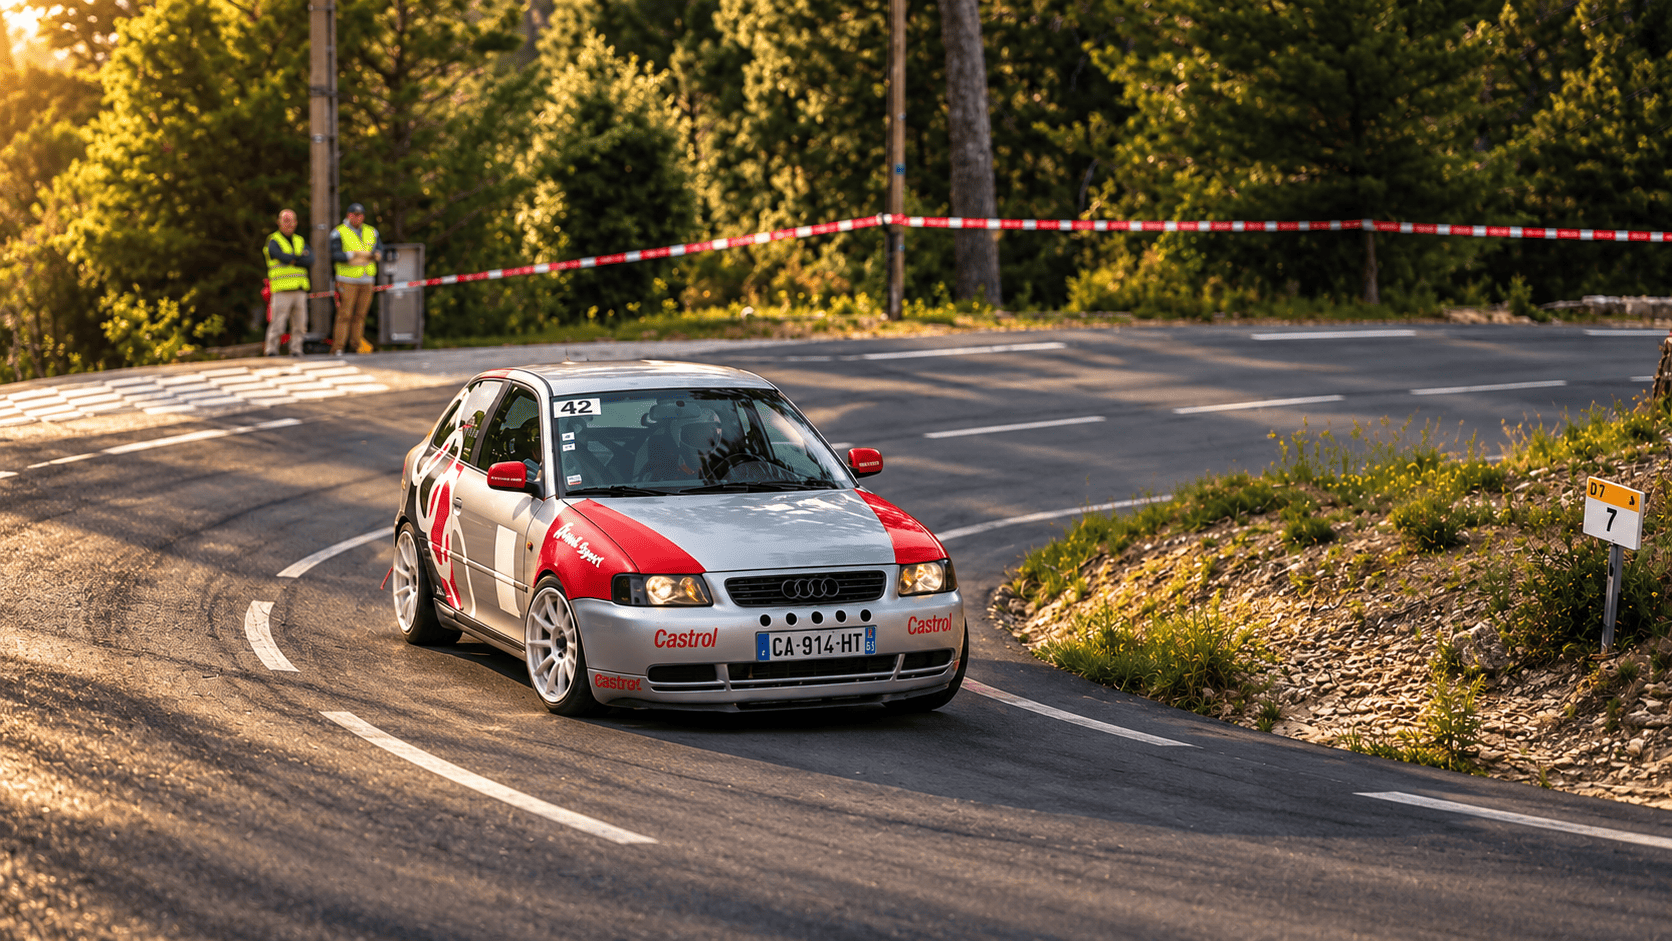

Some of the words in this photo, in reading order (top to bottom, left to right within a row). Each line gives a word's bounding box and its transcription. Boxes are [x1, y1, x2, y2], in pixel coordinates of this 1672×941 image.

[561, 400, 593, 414] 42
[1606, 507, 1618, 532] 7
[908, 612, 953, 635] Castrol
[654, 627, 718, 648] Castrol
[772, 633, 862, 657] CA-914-HT
